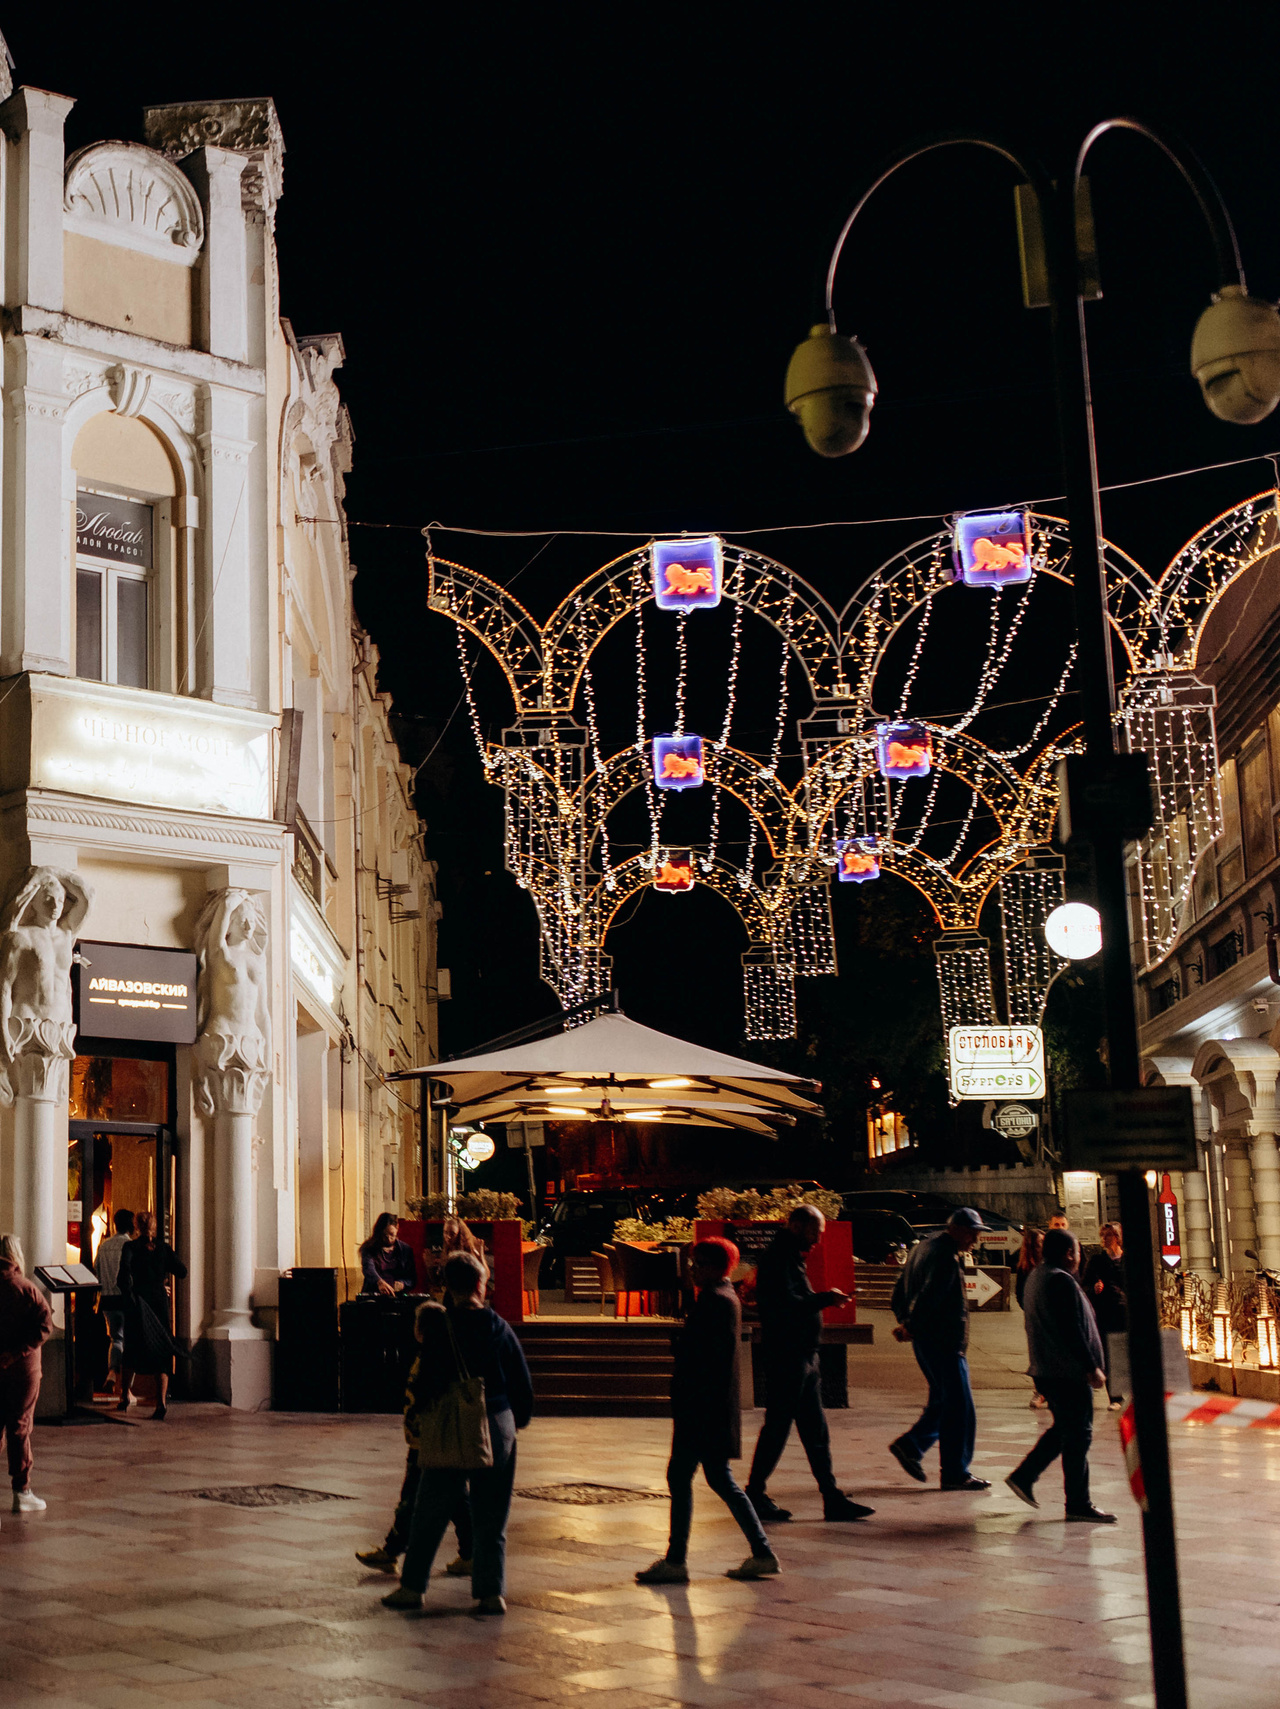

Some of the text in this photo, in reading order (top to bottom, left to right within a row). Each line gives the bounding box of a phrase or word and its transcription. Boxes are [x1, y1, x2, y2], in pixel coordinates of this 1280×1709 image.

[77, 508, 144, 545] Любав
[76, 536, 143, 557] АЛОН КРАСОТ
[89, 978, 188, 997] АЙВАЗОВСКИЙ
[1164, 1203, 1174, 1246] БАР
